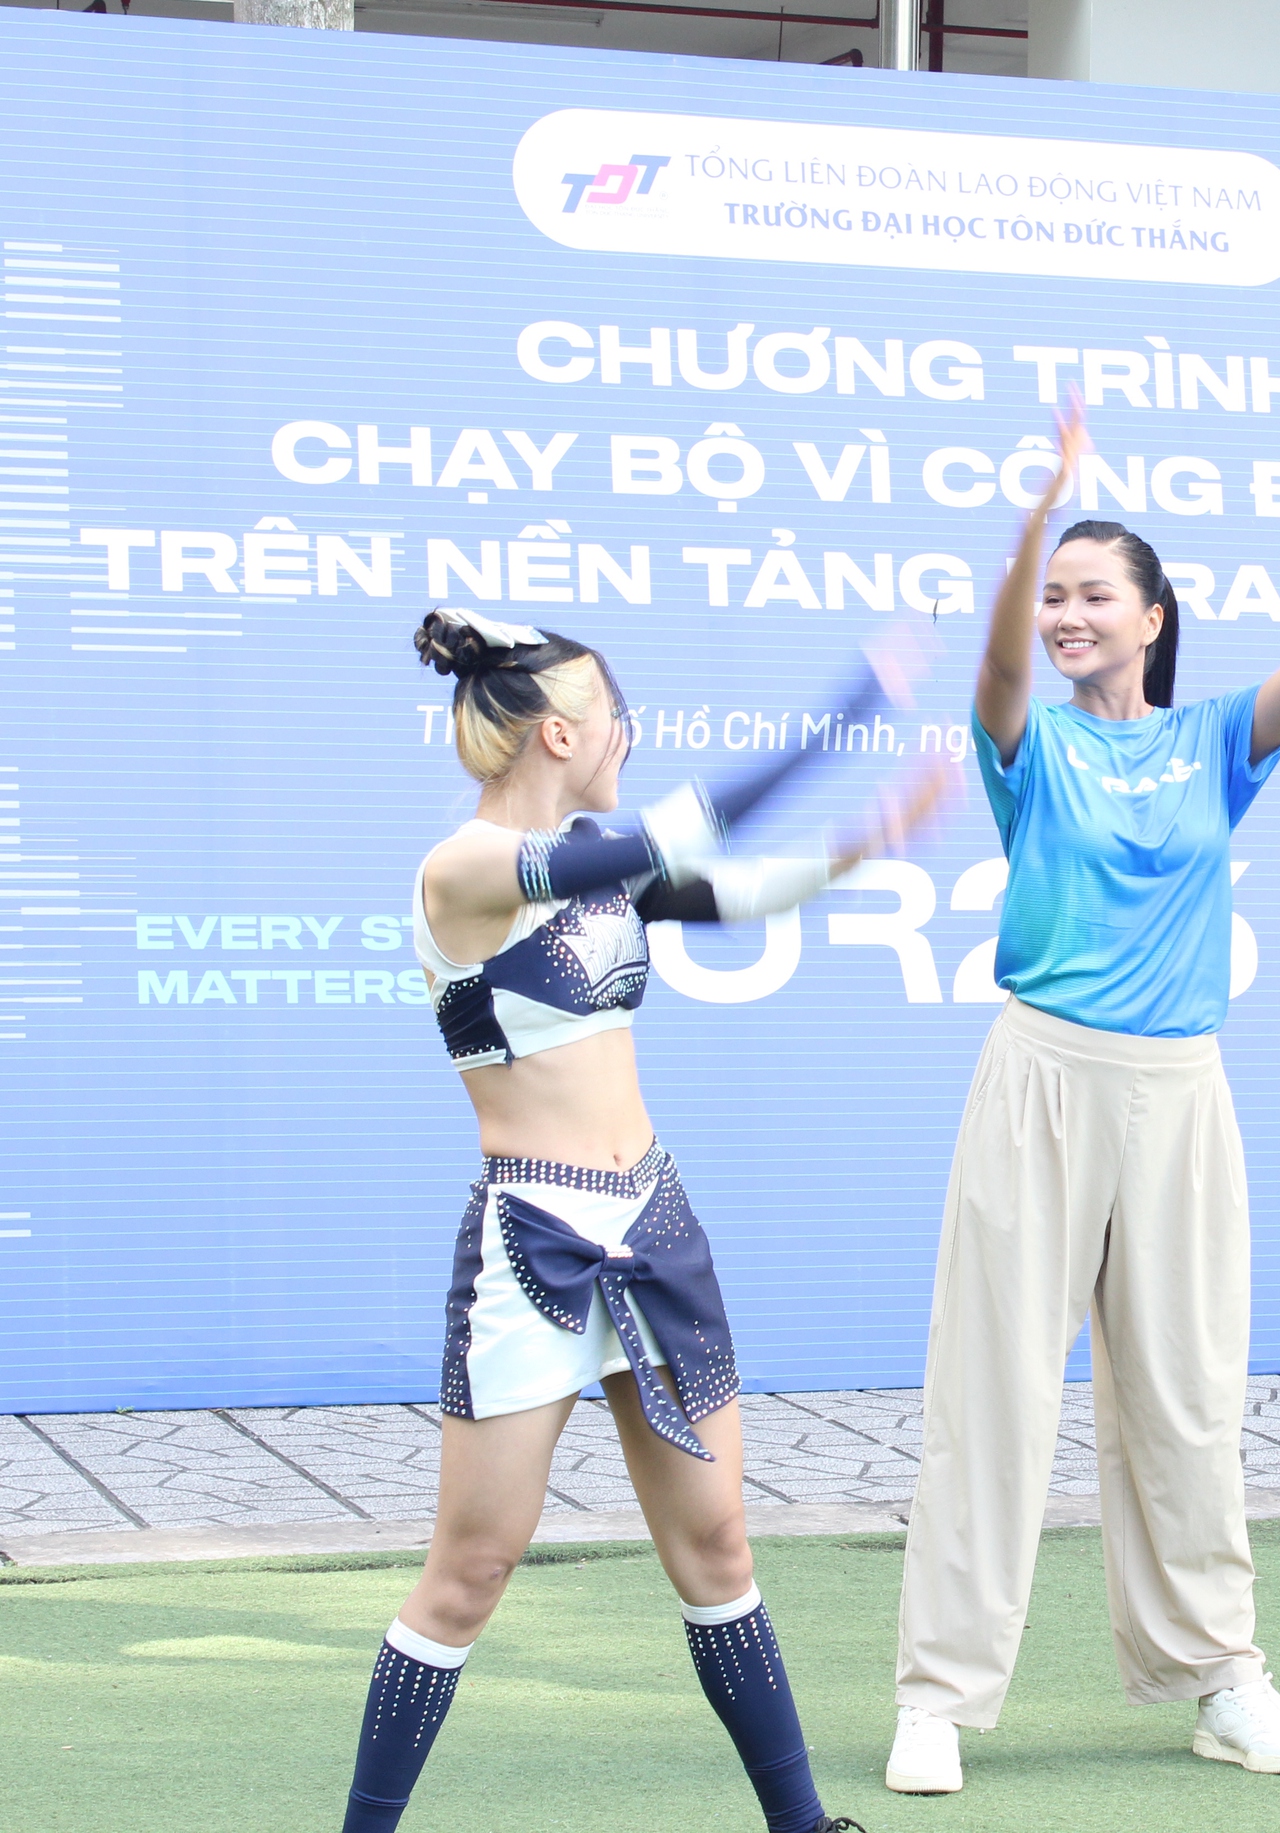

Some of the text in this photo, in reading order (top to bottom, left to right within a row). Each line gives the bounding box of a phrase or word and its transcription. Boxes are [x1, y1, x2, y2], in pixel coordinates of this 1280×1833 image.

[685, 145, 1262, 211] TỔNG LIÊN ĐOÀN LAO ĐỘNG VIỆT NAM
[724, 200, 1230, 252] TRƯỜNG ĐẠI HỌC TÔN ĐỨC THẮNG
[515, 320, 985, 400] CHƯƠNG
[271, 420, 579, 504] CHẠY
[610, 422, 766, 513] BỘ
[792, 428, 892, 503] VÌ
[80, 516, 392, 597] TRÊN
[427, 519, 651, 604] NỀN
[682, 528, 975, 615] TẢNG
[655, 704, 711, 749] Hồ
[723, 711, 789, 751] Chí
[801, 711, 904, 757] Minh,
[136, 914, 344, 951] EVERY
[138, 968, 432, 1005] MATTERS
